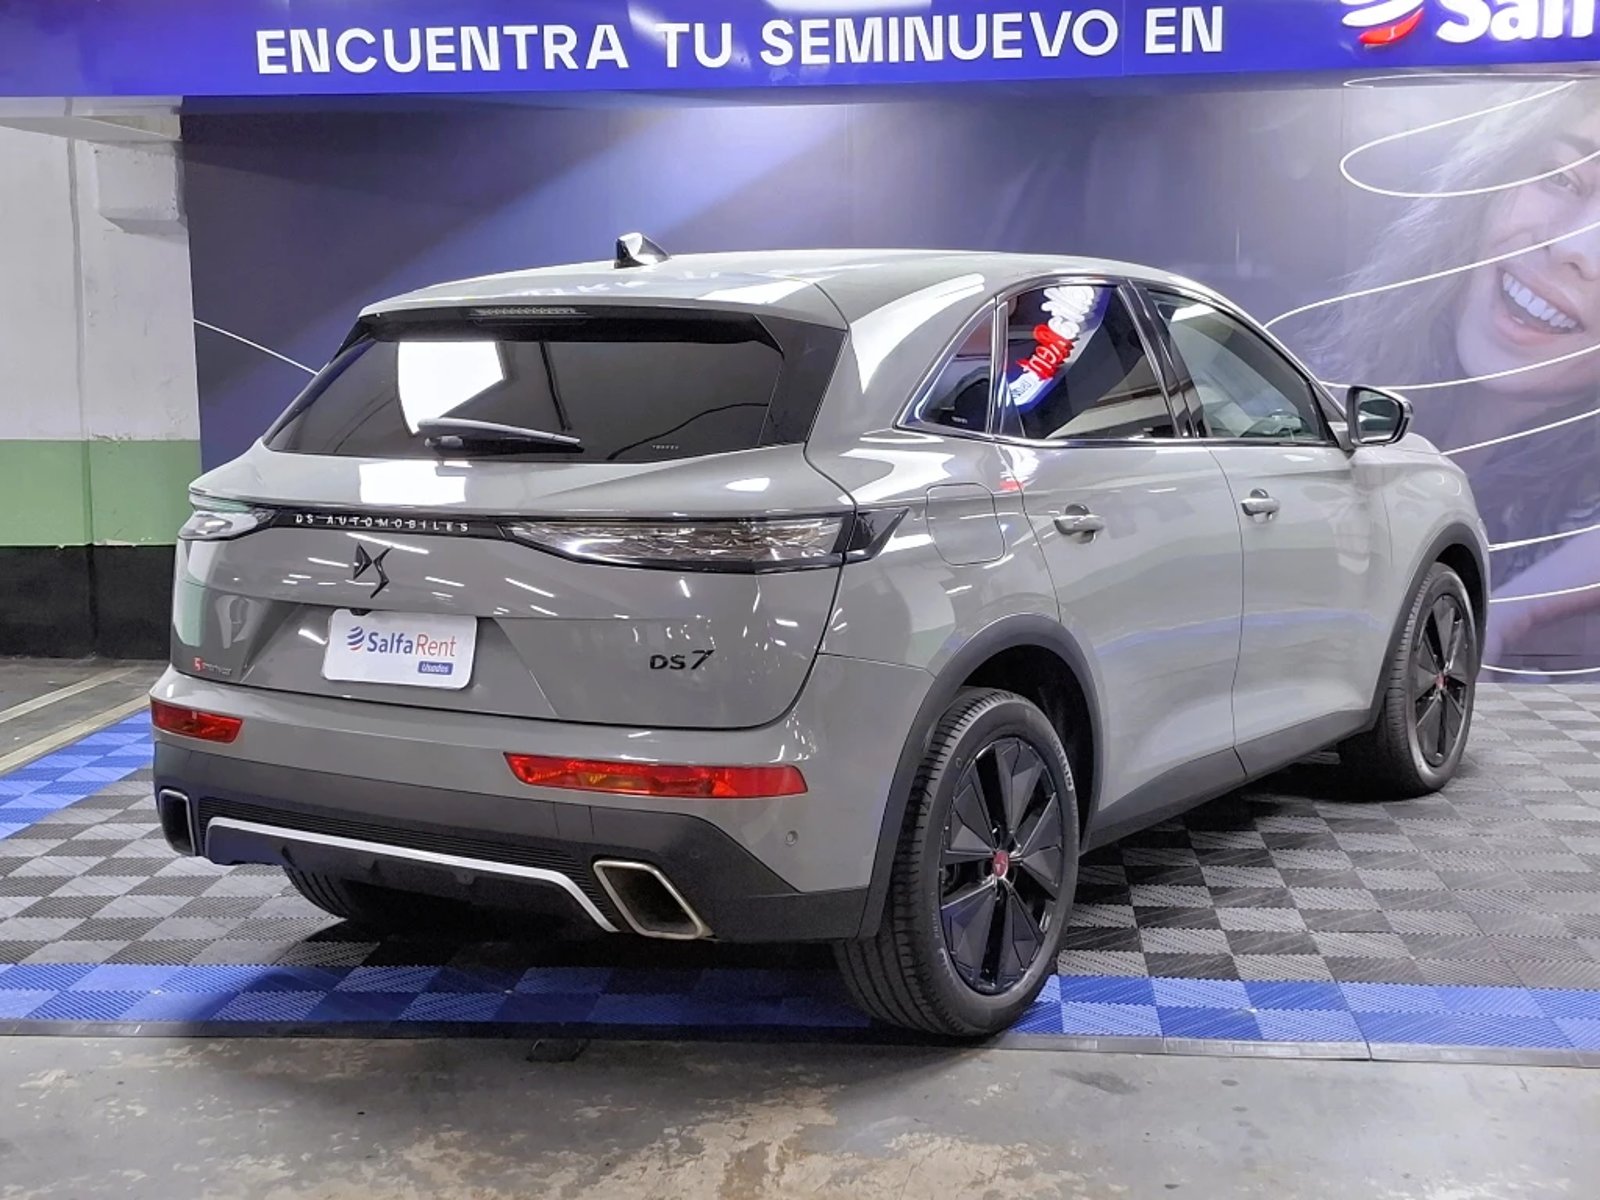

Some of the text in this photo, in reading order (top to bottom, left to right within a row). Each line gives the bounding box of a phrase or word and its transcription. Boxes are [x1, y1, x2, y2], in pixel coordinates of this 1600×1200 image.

[256, 5, 1224, 75] ENCUENTRA TU SEMINUEVO EN
[295, 513, 469, 532] DS AUTOMOBILES
[366, 631, 457, 657] SalfaRent
